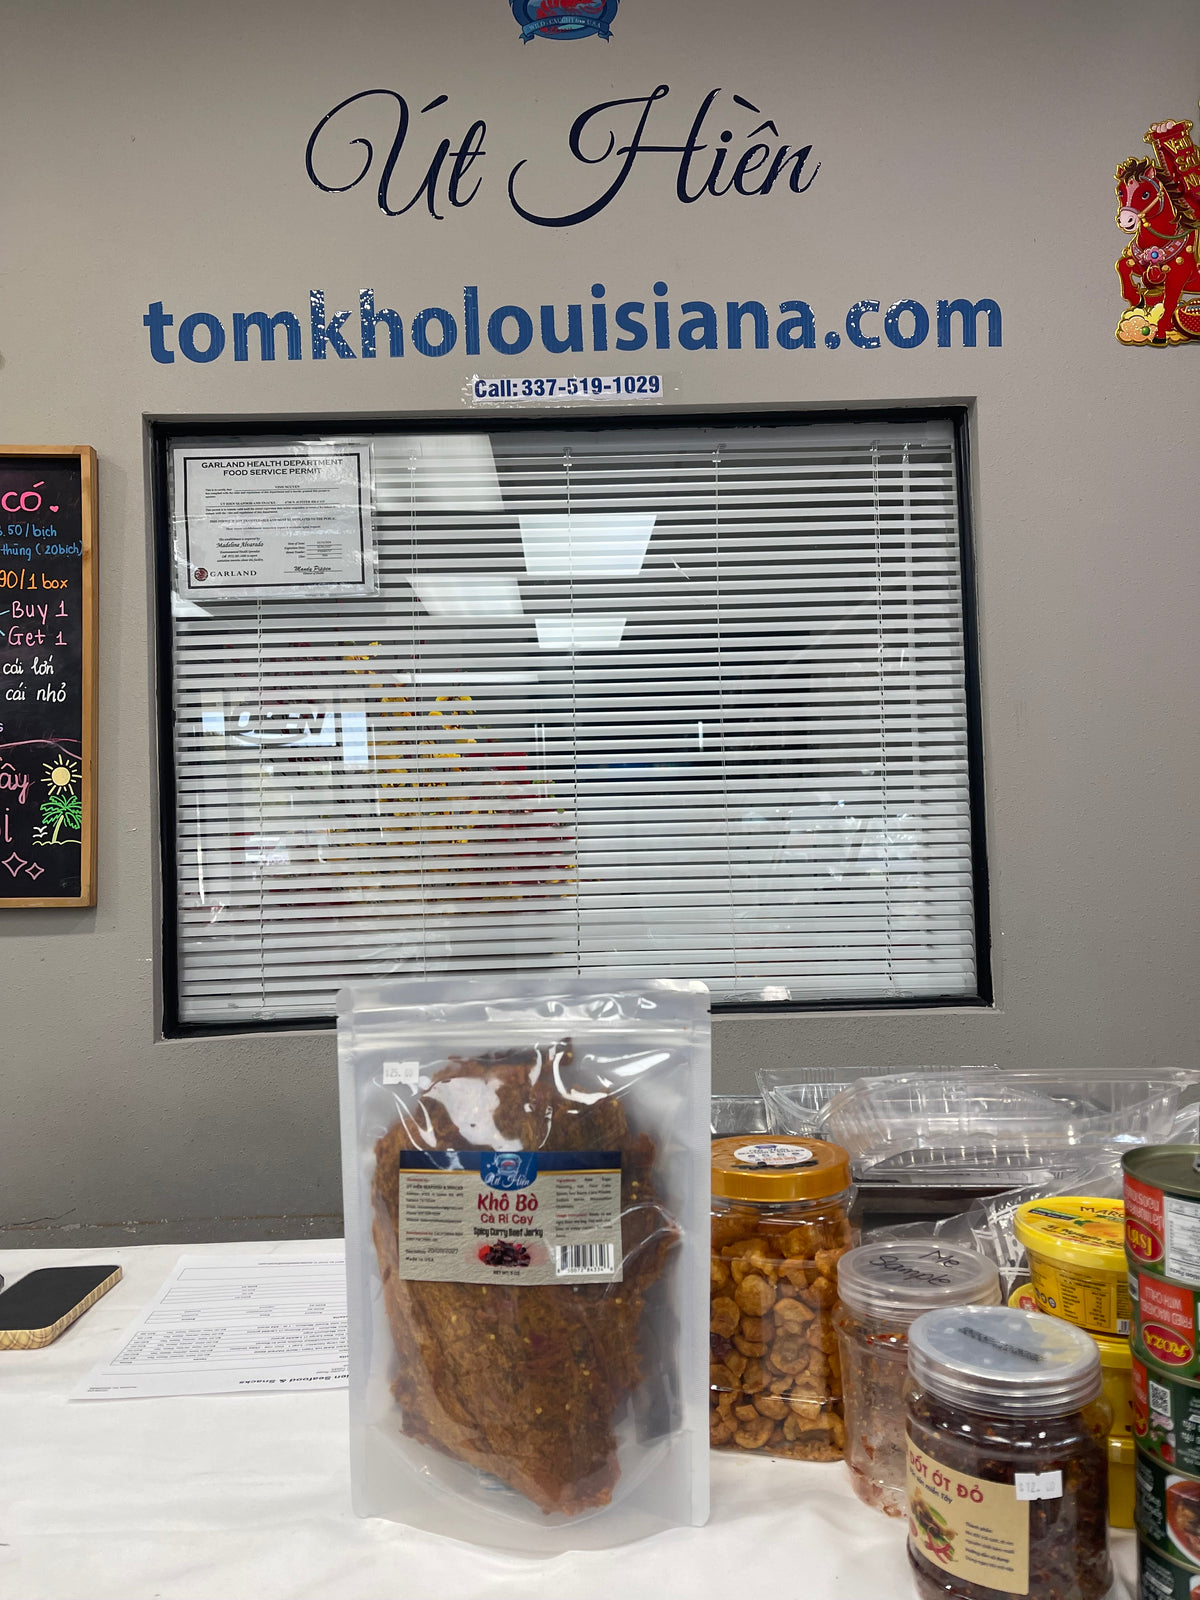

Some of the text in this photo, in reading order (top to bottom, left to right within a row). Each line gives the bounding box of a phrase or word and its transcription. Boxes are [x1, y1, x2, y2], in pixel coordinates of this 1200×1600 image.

[305, 84, 822, 227] Út Hiền
[143, 282, 1003, 364] tomkholouisiana.com
[474, 375, 660, 398] Call: 337-519-1029
[201, 461, 245, 469] GARLAND
[283, 458, 343, 467] DEPARTMENT
[250, 468, 288, 476] SERVICE
[289, 467, 322, 475] PERMIT
[42, 573, 69, 590] box
[210, 570, 257, 578] GARLAND
[12, 600, 69, 625] Buy 1
[8, 625, 68, 647] Get 1
[477, 1191, 510, 1212] Khô
[515, 1193, 538, 1212] Bò
[480, 1213, 495, 1224] Cà
[512, 1214, 534, 1226] Cay
[474, 1227, 489, 1238] Spicy
[490, 1227, 508, 1238] Curry
[508, 1228, 524, 1237] Beef
[524, 1228, 544, 1238] Jerky
[869, 1255, 951, 1286] Sample
[932, 1469, 951, 1492] ỚT
[956, 1483, 984, 1504] ĐỎ
